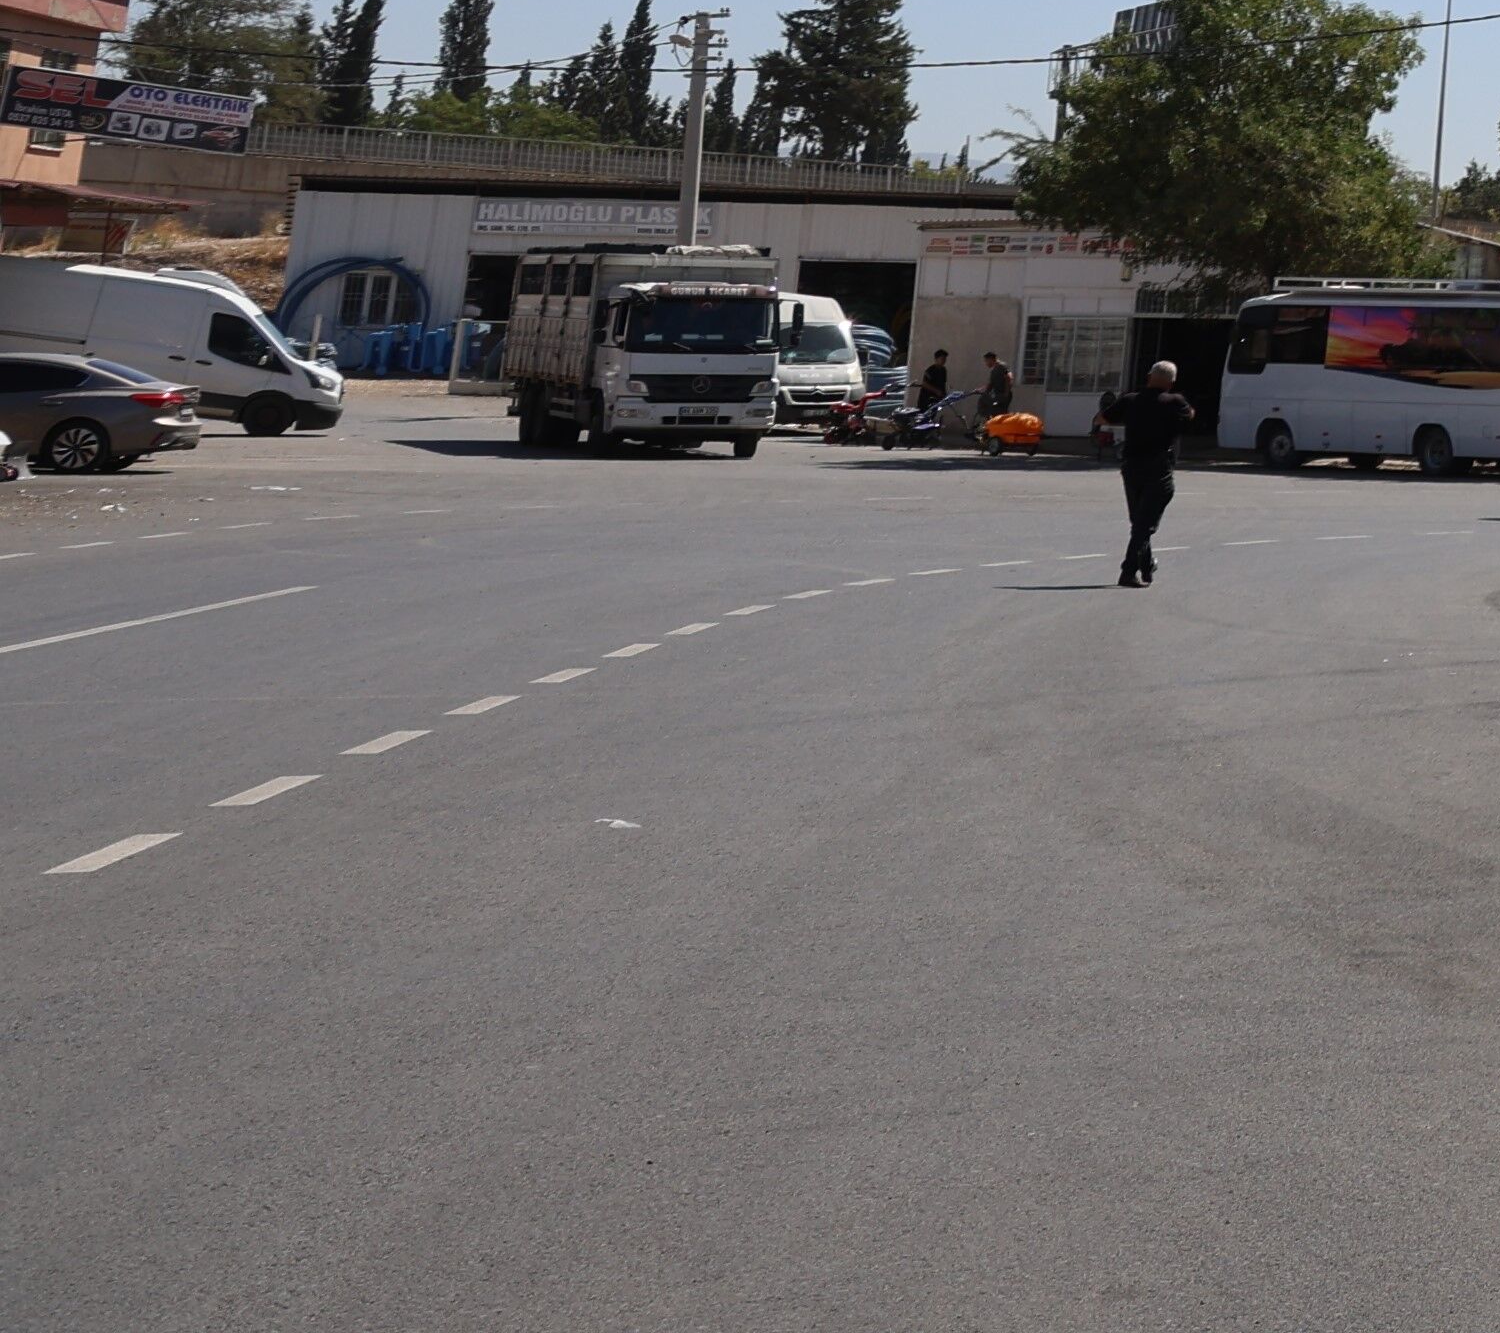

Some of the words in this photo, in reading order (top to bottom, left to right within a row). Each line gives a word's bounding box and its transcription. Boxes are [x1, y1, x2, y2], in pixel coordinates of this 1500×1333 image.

[13, 70, 111, 108] SEL
[129, 86, 168, 101] OTO
[479, 200, 612, 223] HALİMOĞLU
[621, 205, 712, 224] PLASK
